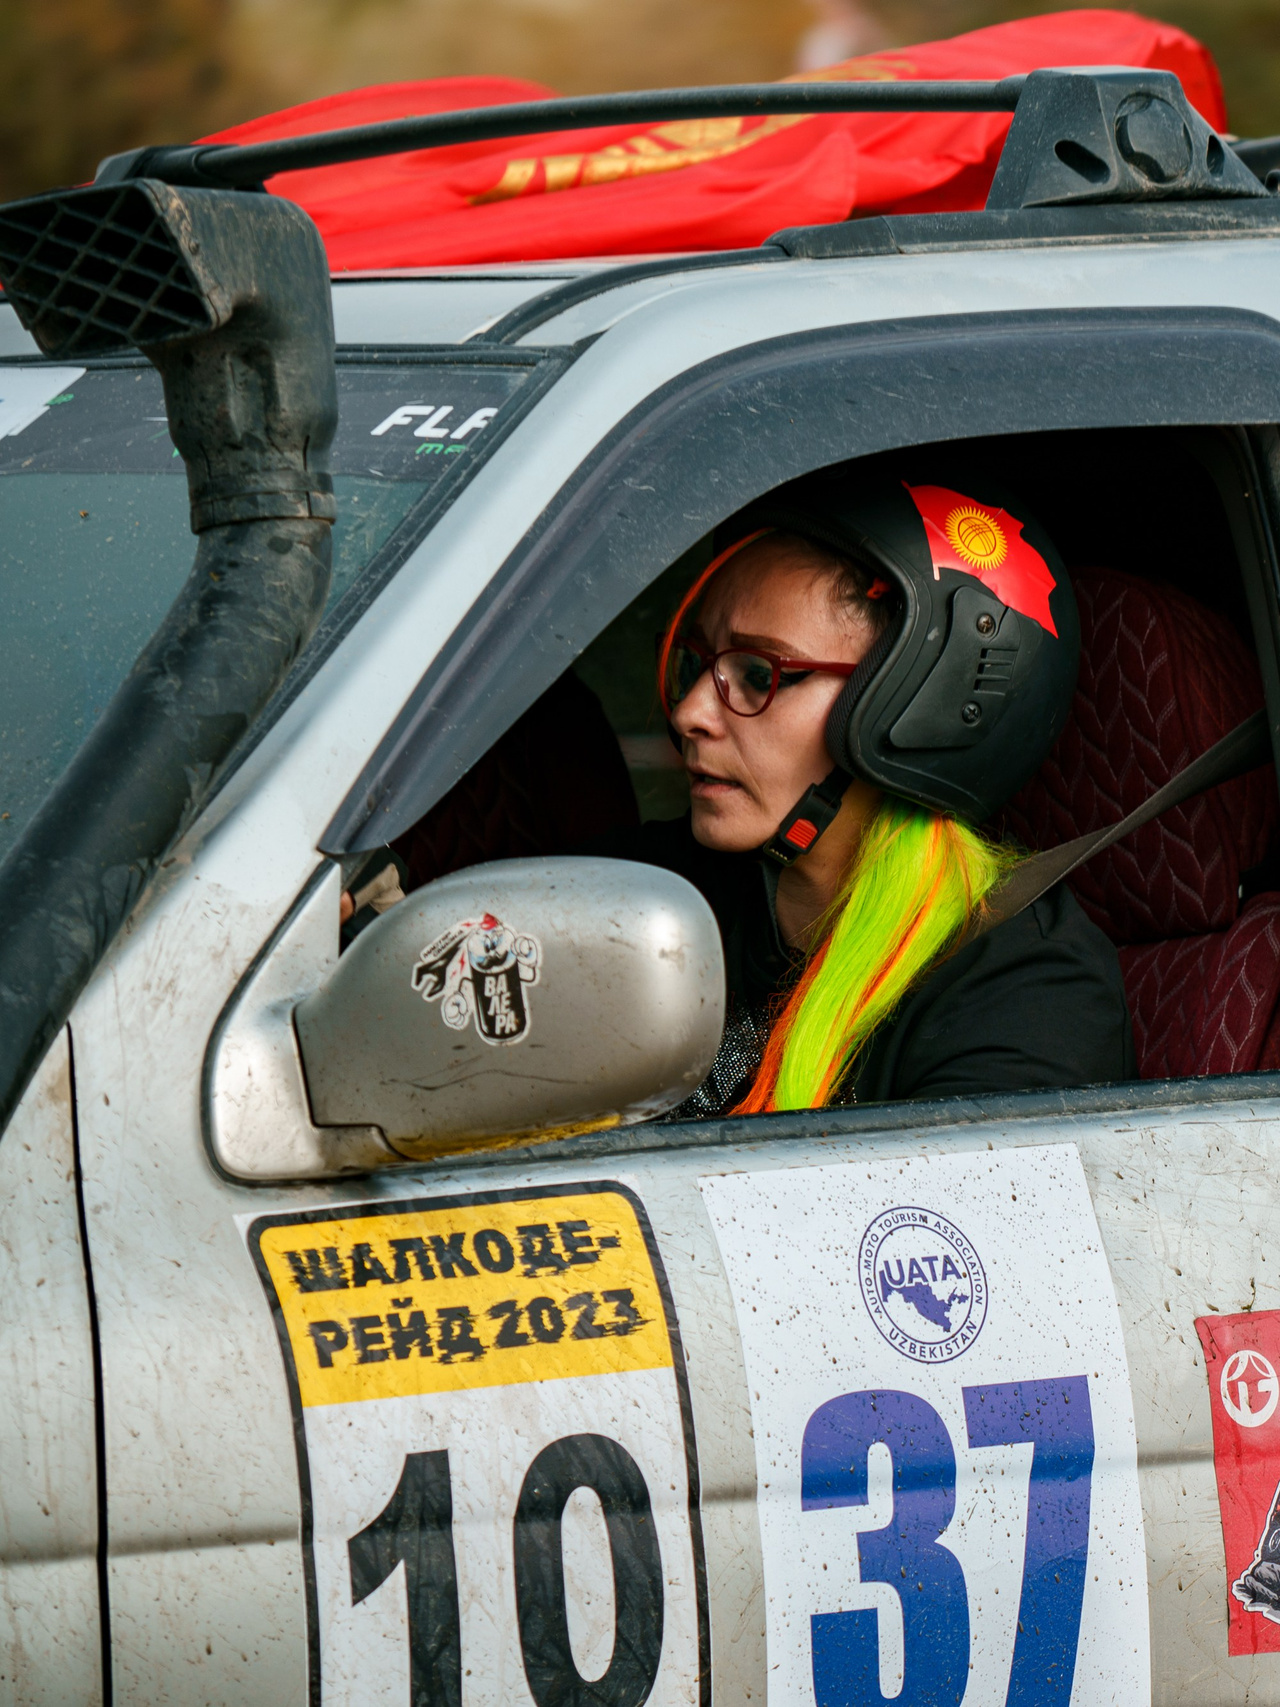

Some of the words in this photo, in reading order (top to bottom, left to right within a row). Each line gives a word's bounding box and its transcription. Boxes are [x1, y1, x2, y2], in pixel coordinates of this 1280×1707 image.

[284, 1220, 622, 1294] ШАЛКОДЕ-
[878, 1213, 928, 1232] TOURISM
[934, 1221, 983, 1305] ASSOCIATION
[883, 1254, 963, 1287] UATA
[307, 1297, 489, 1368] РЕЙД
[485, 1288, 655, 1349] 2023
[889, 1320, 977, 1359] UZBEKISTAN
[347, 1433, 664, 1707] 10
[801, 1374, 1095, 1707] 37
